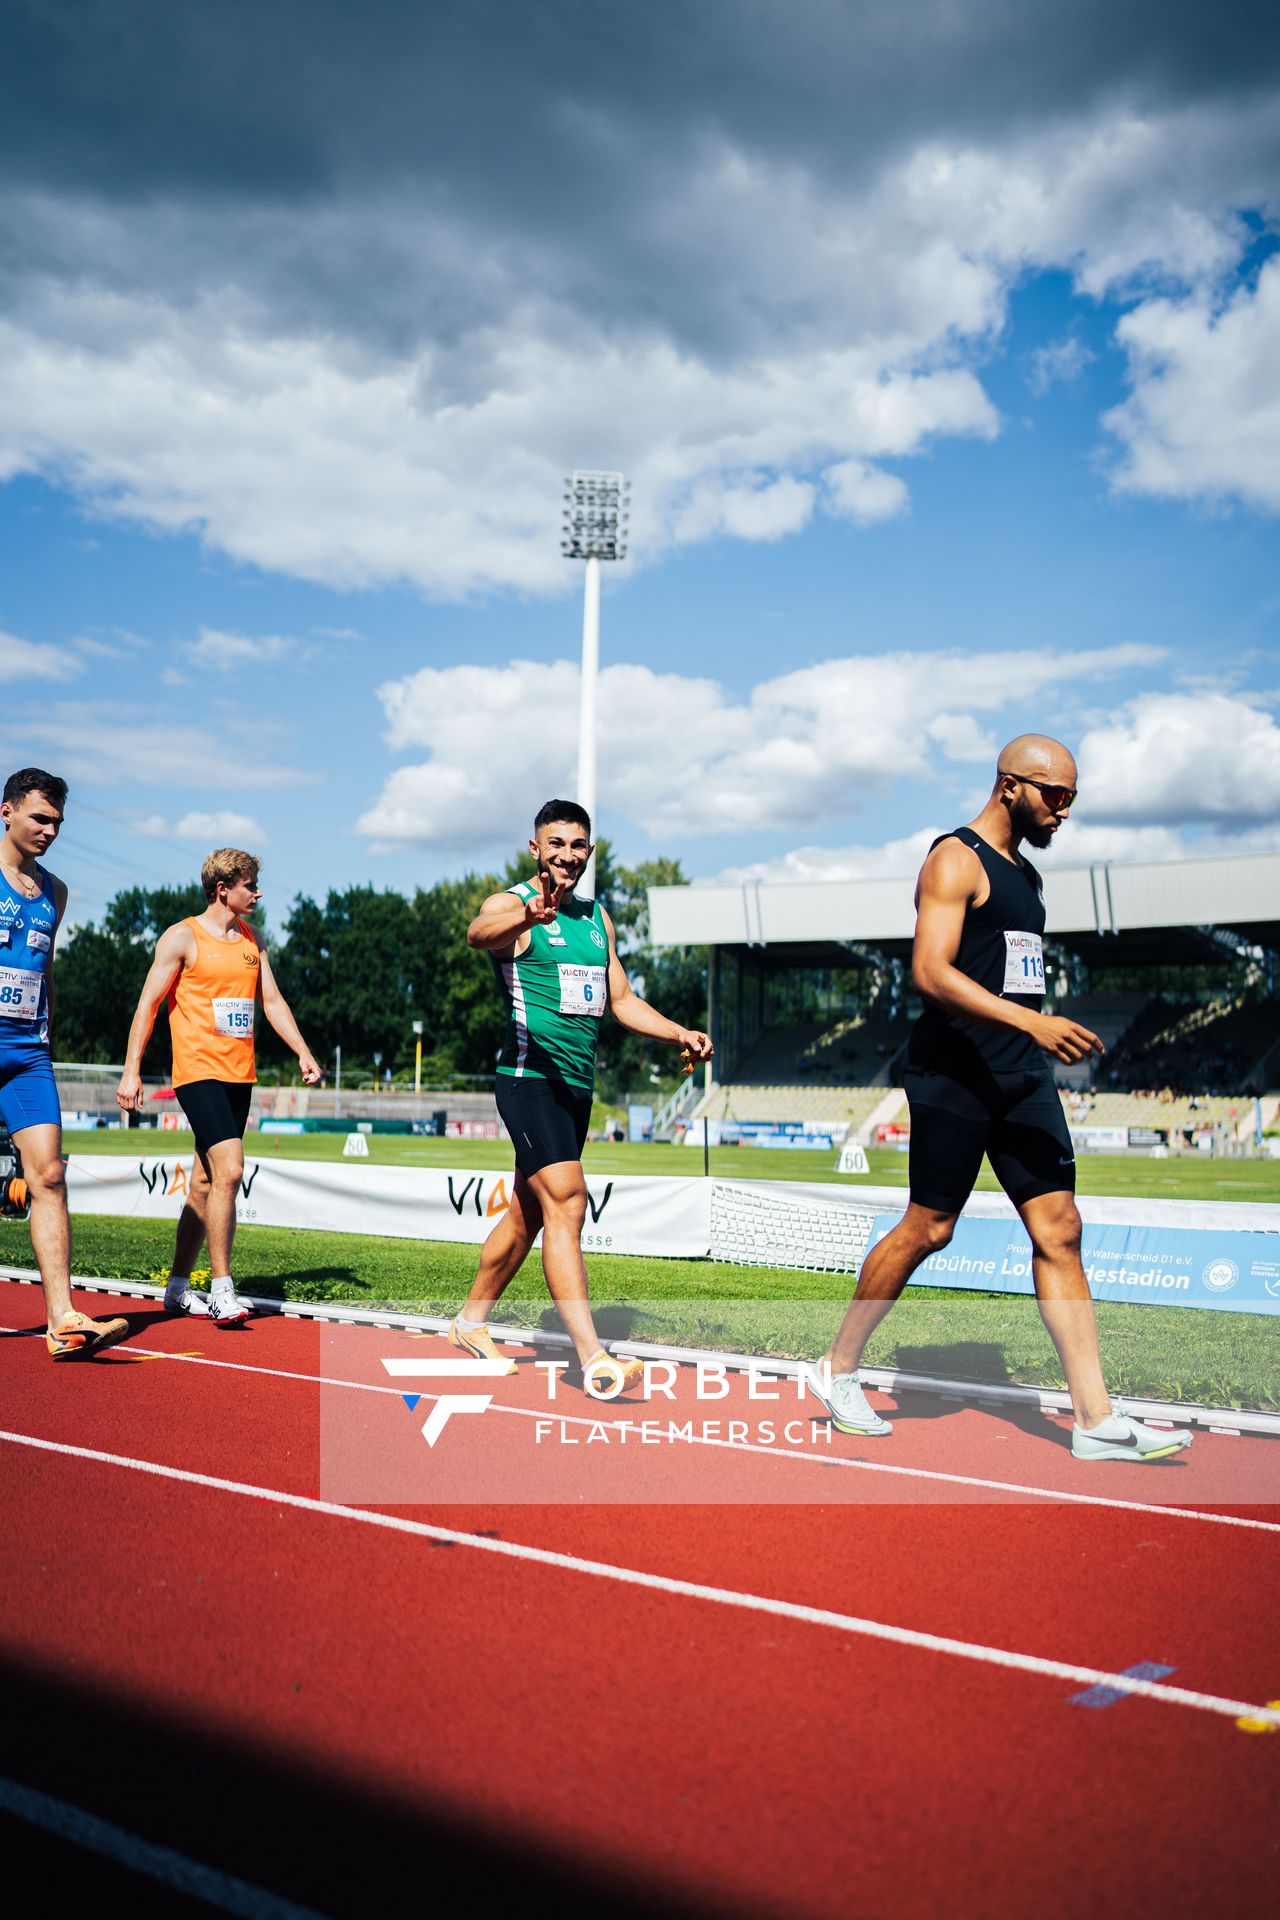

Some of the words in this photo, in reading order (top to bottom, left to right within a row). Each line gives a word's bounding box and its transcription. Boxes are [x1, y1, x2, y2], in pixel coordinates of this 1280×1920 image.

[561, 969, 588, 977] VIACTIV
[1022, 955, 1043, 977] 113
[583, 984, 593, 1002] 6
[227, 1013, 248, 1027] 155
[348, 1139, 364, 1153] 50
[845, 1152, 863, 1169] 60
[1092, 1248, 1158, 1263] Wattenscheid
[1160, 1254, 1173, 1264] 01
[1175, 1256, 1192, 1265] e.V.
